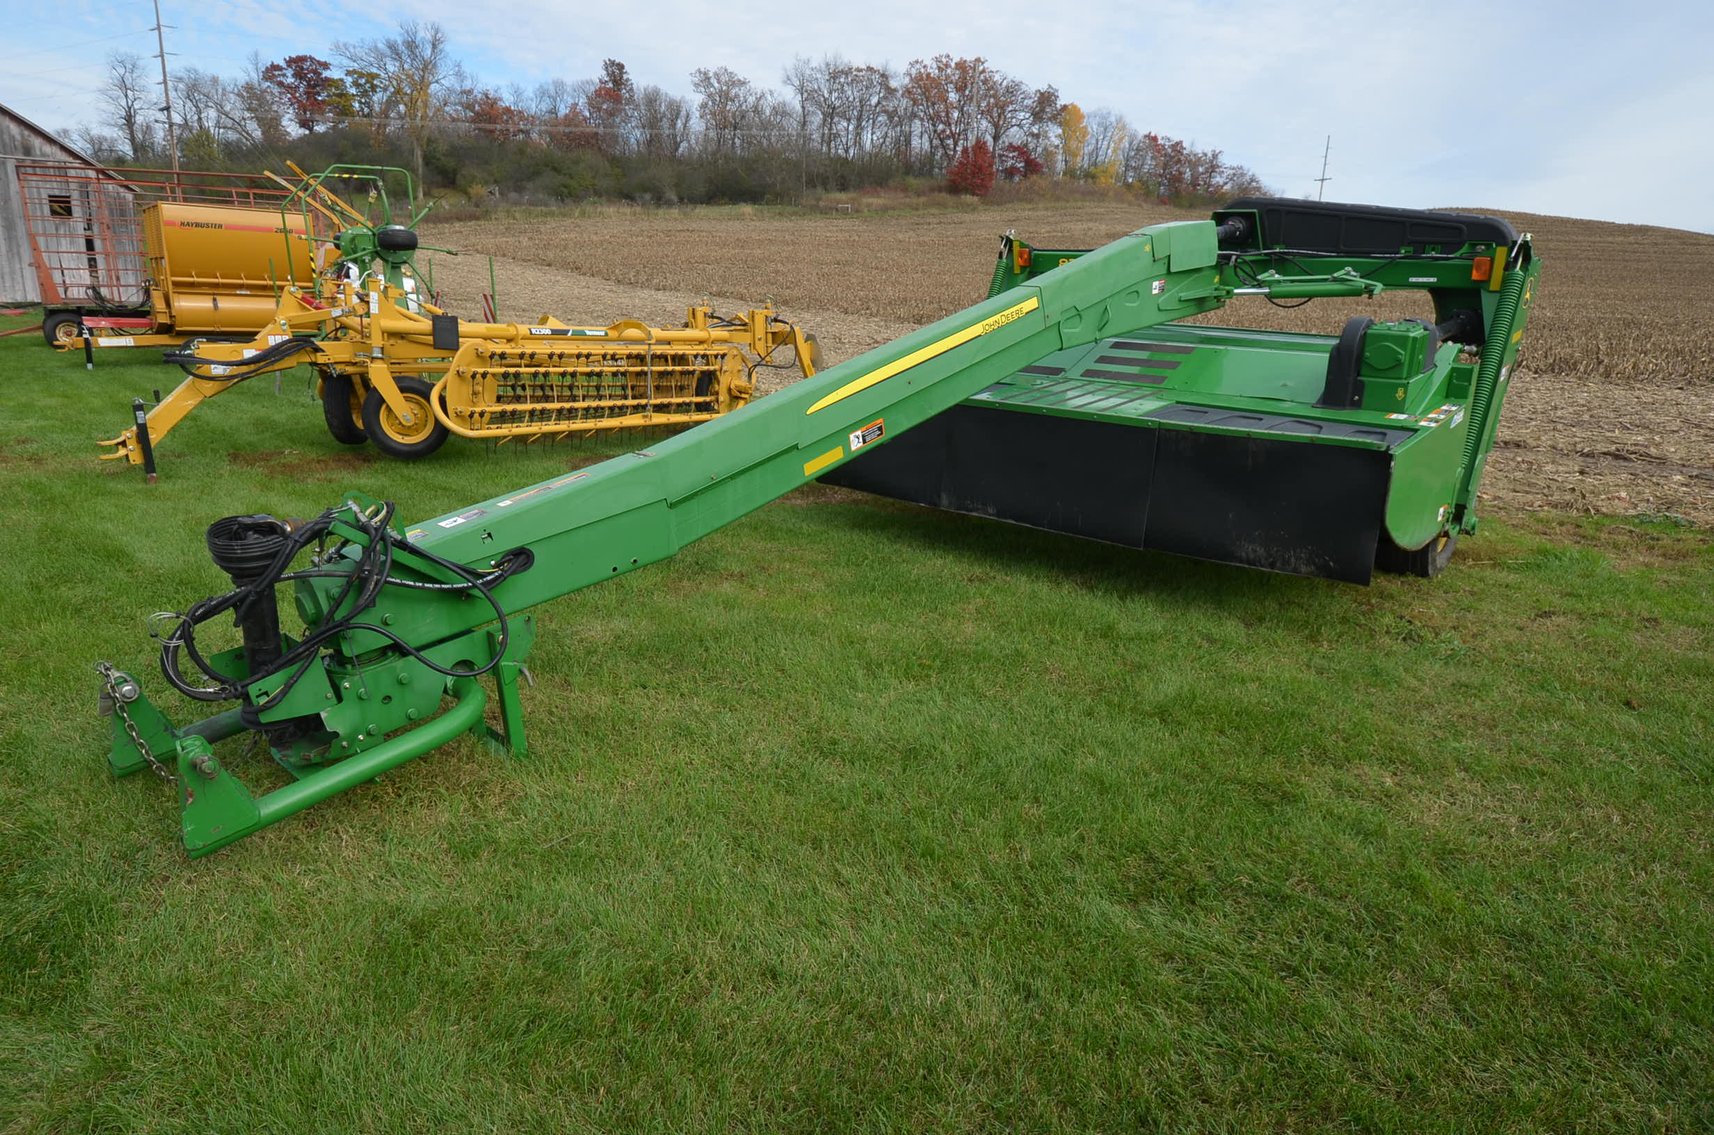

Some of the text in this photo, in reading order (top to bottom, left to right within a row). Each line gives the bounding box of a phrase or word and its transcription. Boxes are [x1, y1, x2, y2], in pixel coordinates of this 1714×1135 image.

[180, 221, 223, 230] HAYBUSTER
[981, 307, 1025, 334] JOHN DEERE
